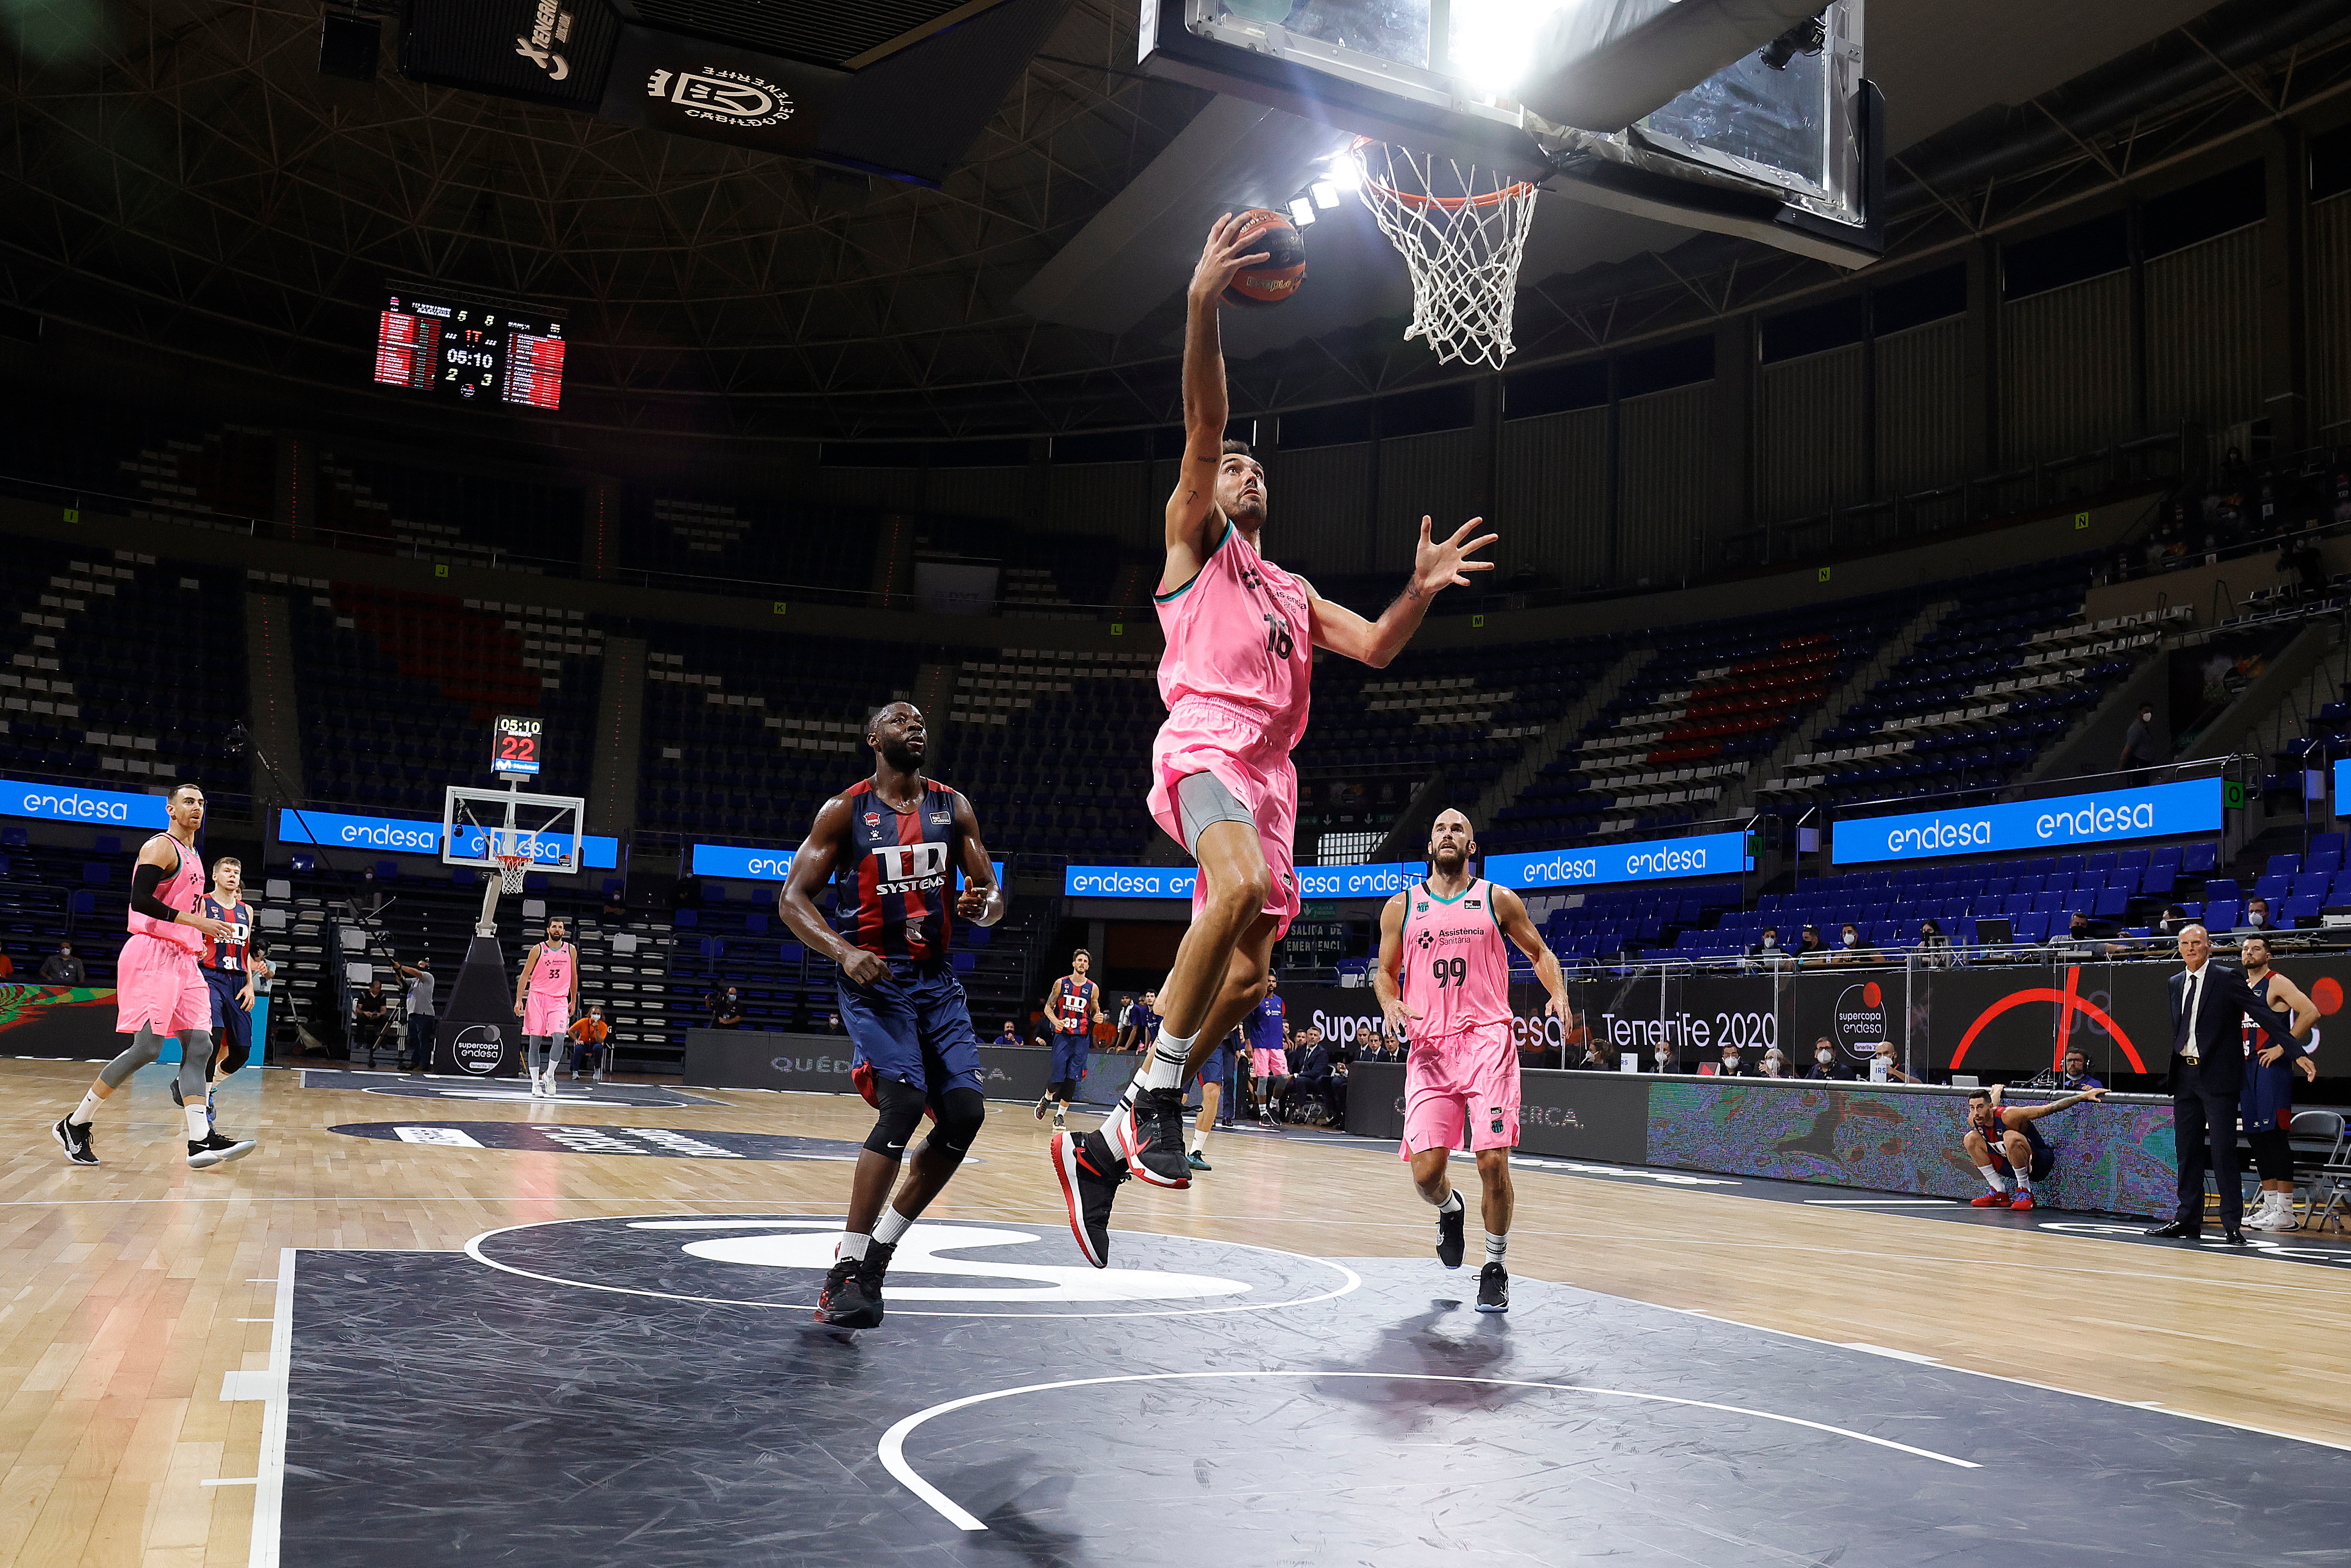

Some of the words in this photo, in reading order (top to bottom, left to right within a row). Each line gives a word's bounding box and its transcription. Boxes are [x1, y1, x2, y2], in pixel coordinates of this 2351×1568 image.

[702, 66, 794, 105] TENERIFE
[685, 110, 776, 126] CABILDO
[772, 106, 794, 120] DE
[457, 311, 468, 321] 5
[484, 316, 494, 326] 8
[465, 330, 482, 342] 1T
[447, 349, 493, 368] 05:10
[446, 368, 458, 381] 2
[481, 374, 492, 386] 3
[1821, 570, 1827, 579] N
[776, 604, 783, 613] K
[1474, 616, 1482, 625] M
[501, 718, 540, 733] 05:10
[501, 736, 535, 761] 22
[23, 793, 127, 820] endesa
[2036, 802, 2153, 838] endesa
[342, 824, 433, 848] endesa
[1888, 819, 1990, 852] endesa
[471, 835, 560, 858] enesa
[748, 856, 792, 875] end
[872, 842, 947, 881] TD
[1524, 856, 1595, 882] endesa
[1627, 846, 1705, 874] endesa
[876, 875, 947, 895] SYSTEMS
[1074, 872, 1159, 892] endesa
[1299, 872, 1339, 892] esa
[1349, 869, 1422, 893] endesa
[220, 922, 248, 941] D
[1439, 927, 1484, 937] Assistència
[1286, 940, 1346, 951] EMERENCI
[1439, 937, 1471, 946] Sanitària
[549, 969, 560, 979] 33
[1433, 957, 1467, 989] 99
[1063, 994, 1088, 1009] TD
[1839, 1013, 1881, 1021] supercopa
[1844, 1020, 1882, 1033] endesa
[1509, 1015, 1564, 1046] esa
[1602, 1012, 1710, 1047] Tenerife
[1716, 1013, 1776, 1049] 2020
[461, 1049, 498, 1058] endesa
[770, 1056, 853, 1073] QUÉD
[1520, 1105, 1585, 1130] ERCA.
